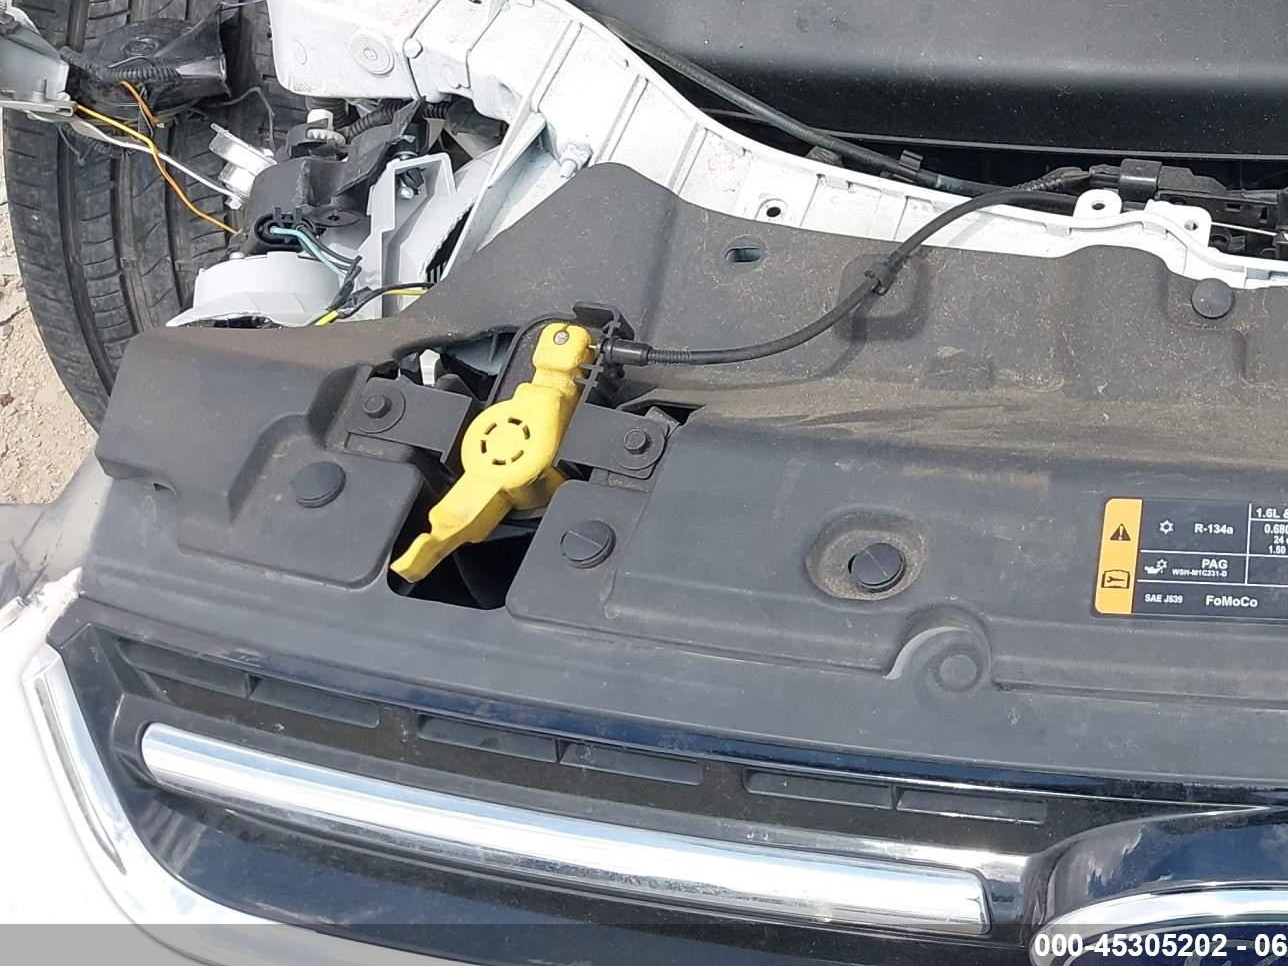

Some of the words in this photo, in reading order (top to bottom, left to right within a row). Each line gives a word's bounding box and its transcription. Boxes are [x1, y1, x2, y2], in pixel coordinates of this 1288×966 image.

[1256, 507, 1281, 519] 1.6L
[1194, 523, 1234, 535] R-134a
[1273, 536, 1284, 544] 24
[1268, 545, 1286, 554] 1.50
[1201, 558, 1228, 569] PAG
[1145, 593, 1162, 603] SAE
[1205, 594, 1258, 607] FoMoCo
